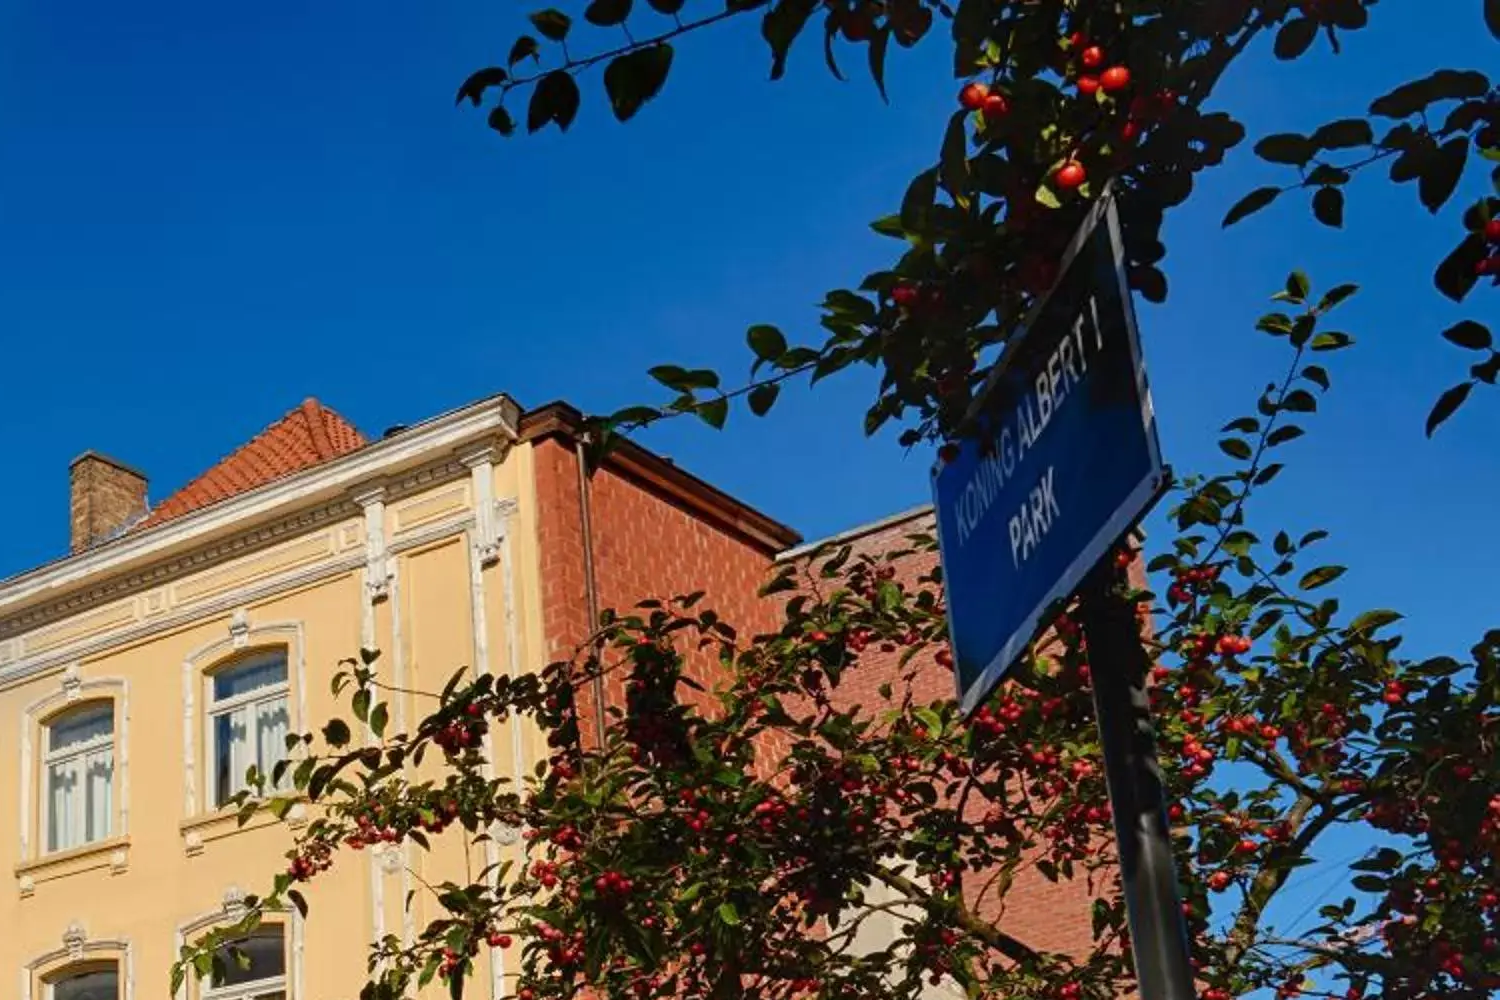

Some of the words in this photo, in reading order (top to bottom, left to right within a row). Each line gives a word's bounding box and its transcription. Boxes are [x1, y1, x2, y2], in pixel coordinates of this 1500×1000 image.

[955, 427, 1016, 547] KONING
[1016, 313, 1088, 463] ALBERT
[1090, 295, 1103, 351] I
[1008, 465, 1061, 570] PARK
